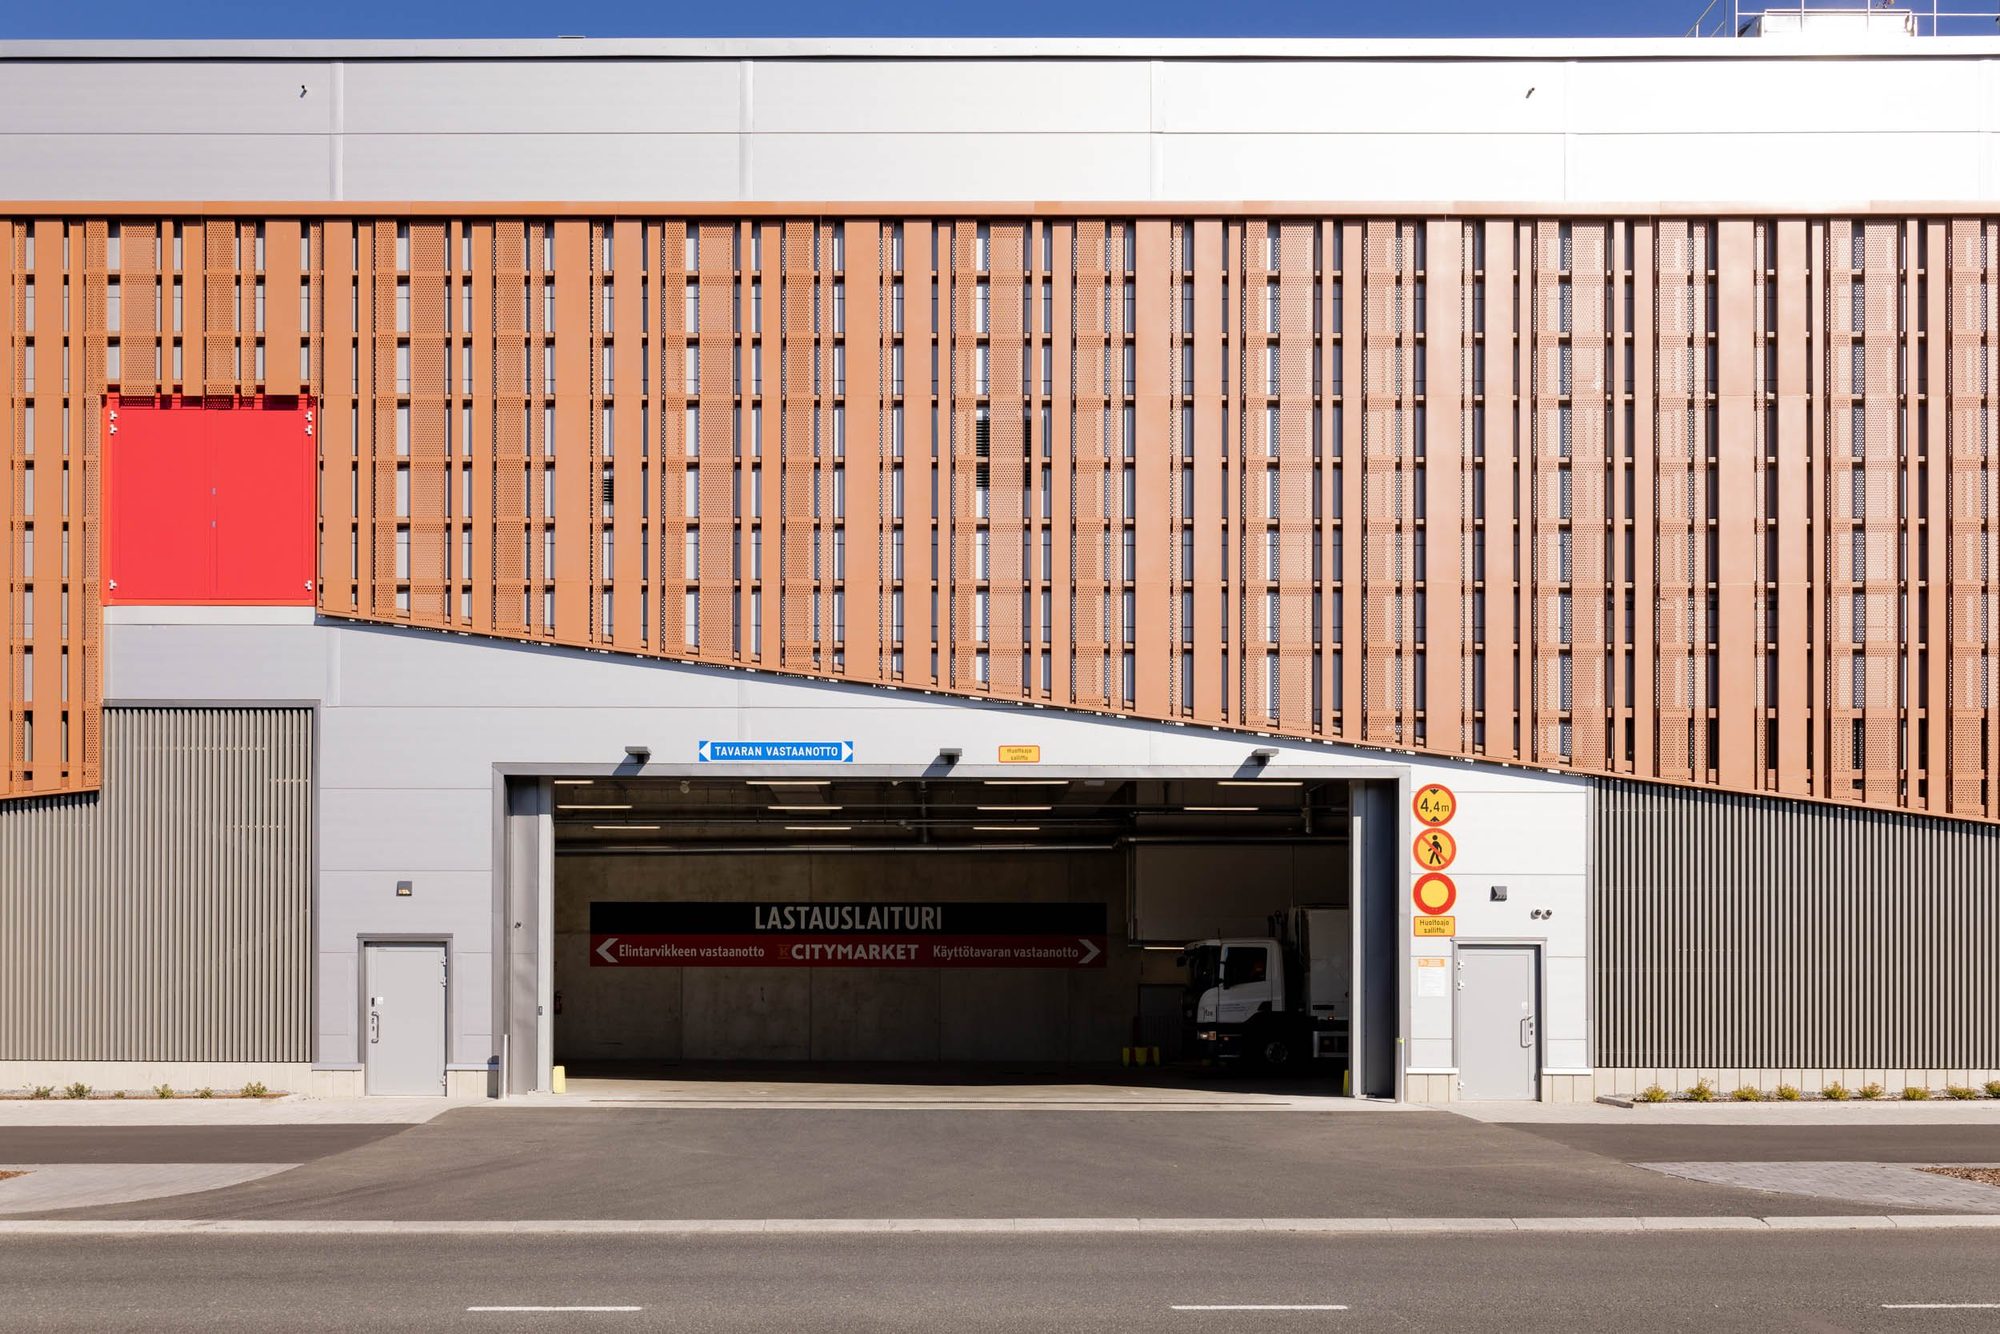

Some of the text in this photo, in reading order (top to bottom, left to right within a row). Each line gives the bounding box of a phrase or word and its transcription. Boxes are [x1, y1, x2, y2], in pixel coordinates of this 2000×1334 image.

[714, 746, 839, 757] TAVARAN VASTAANOTTO
[754, 906, 943, 930] LASTAUSLAITURI
[618, 943, 765, 957] Elintarvikkeen vastaanotto
[791, 943, 920, 960] CITYMARKET
[933, 945, 1079, 961] Käyttötavaran vastaanotto
